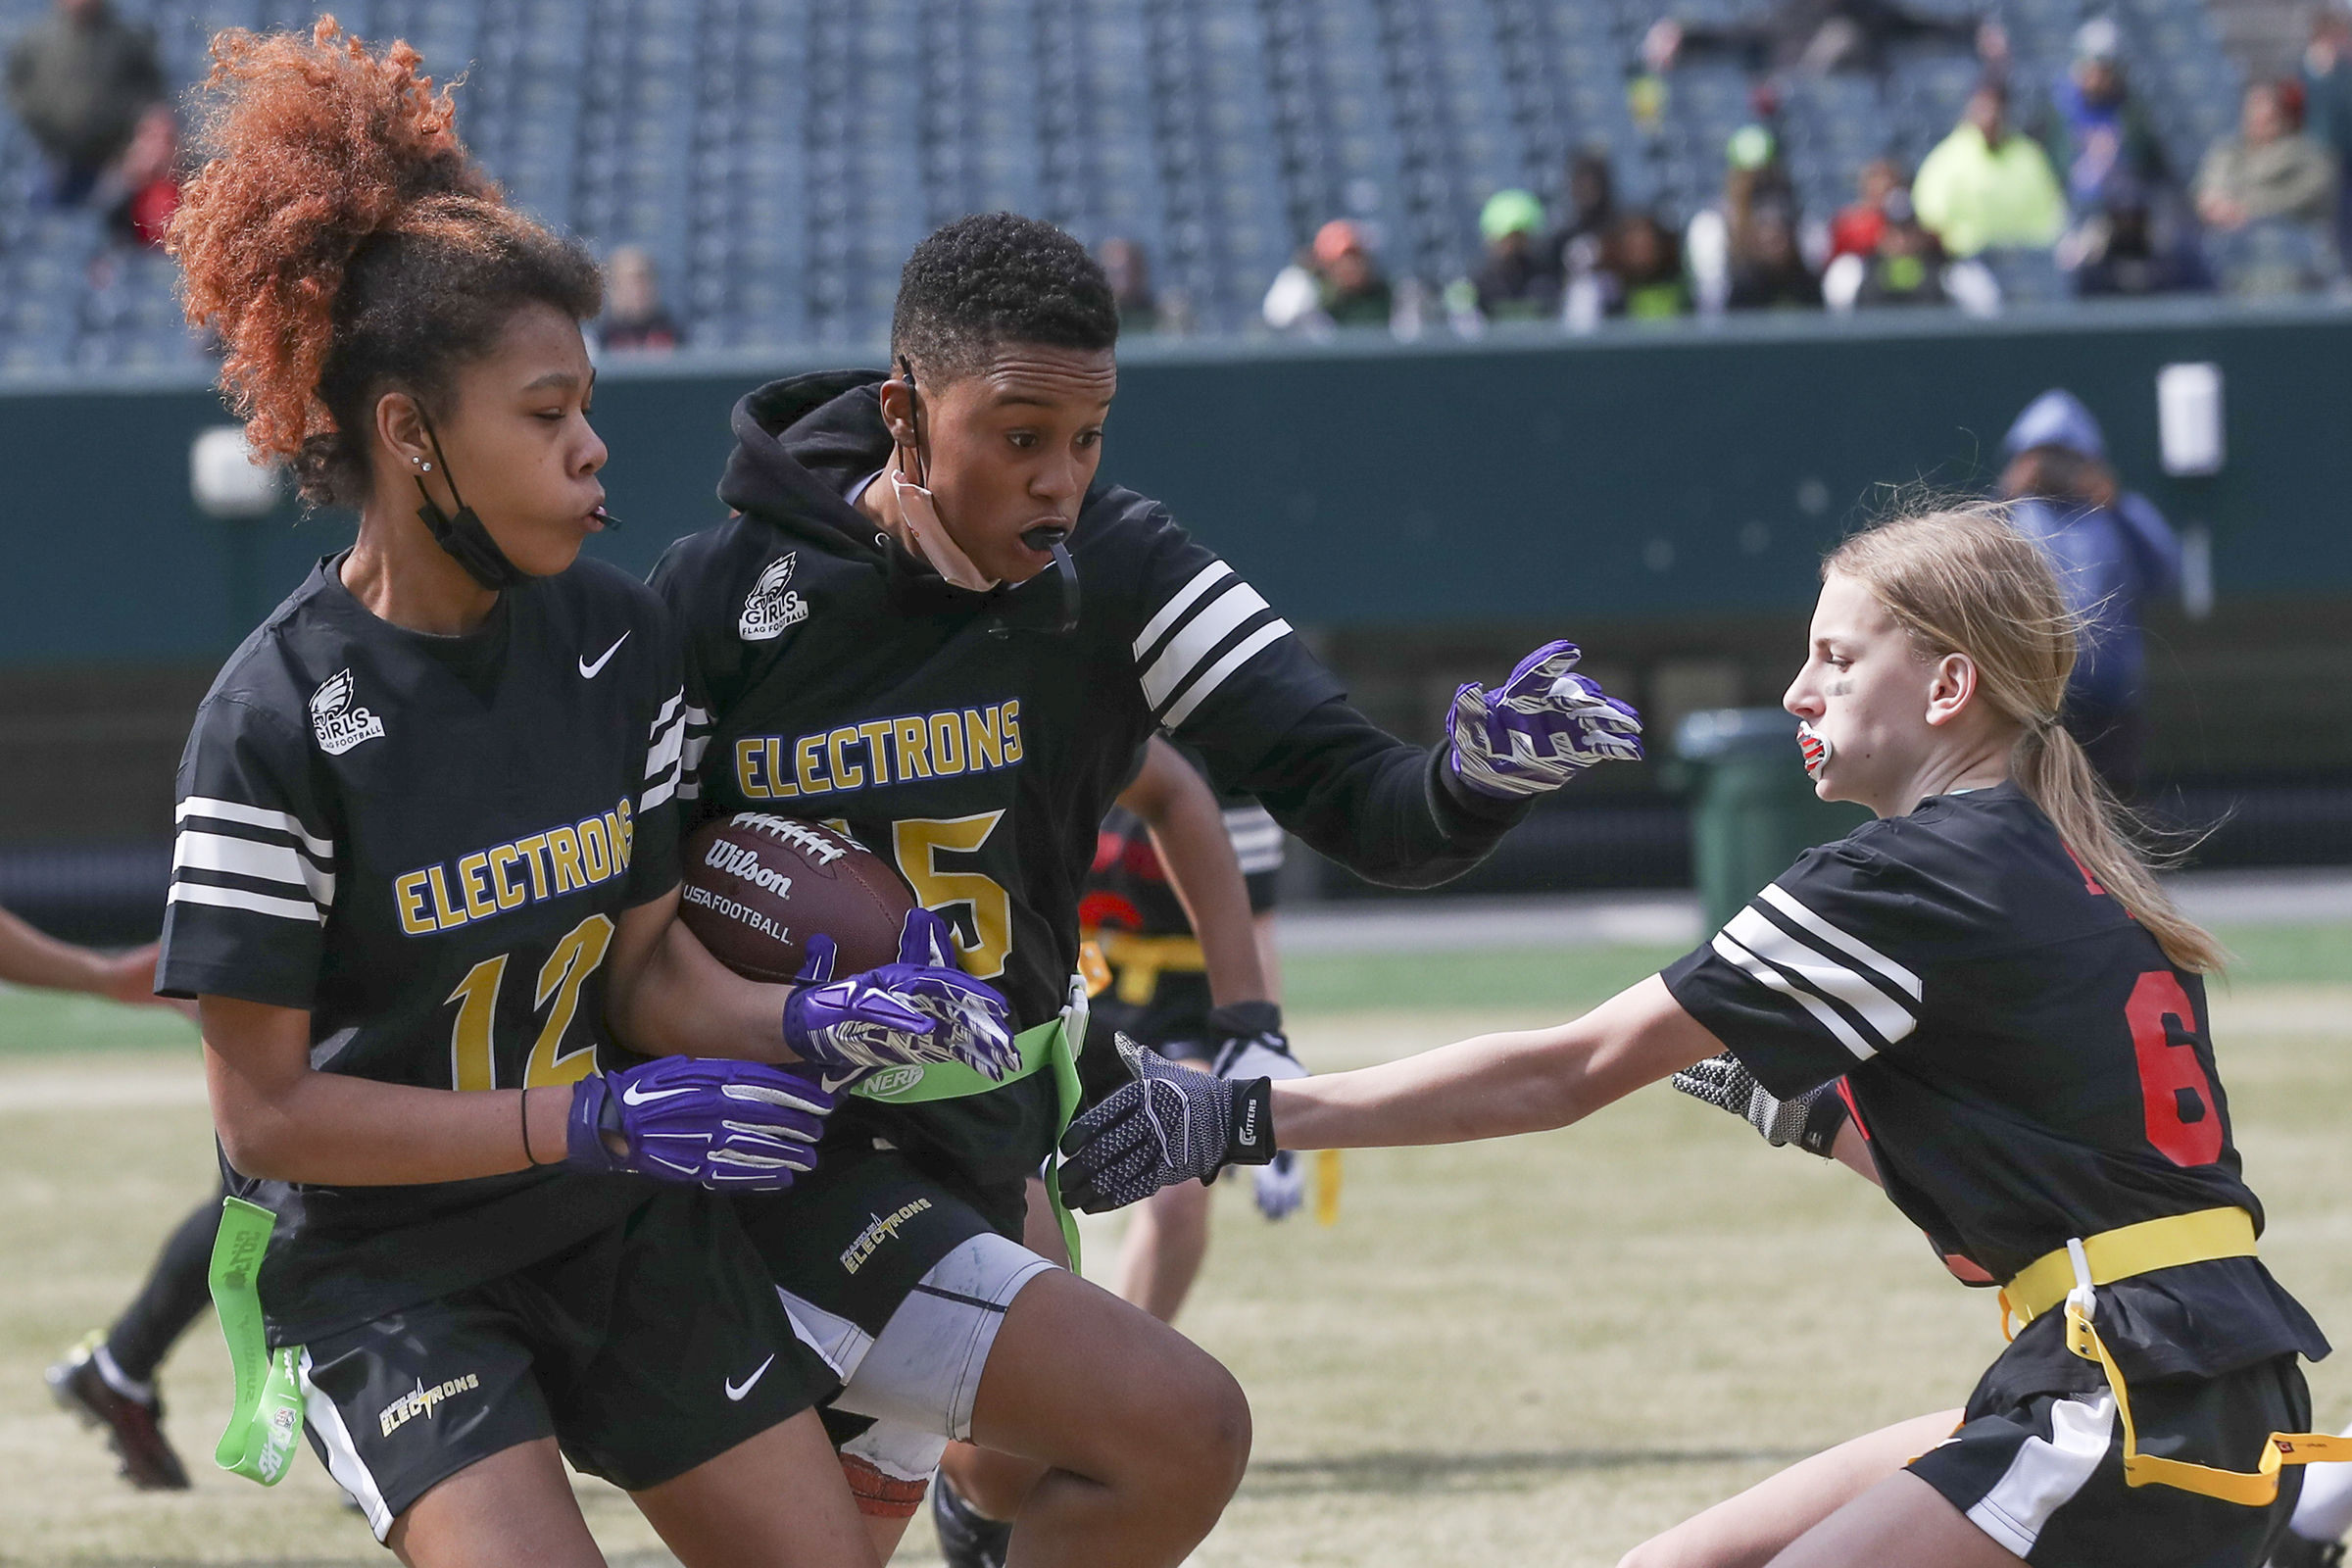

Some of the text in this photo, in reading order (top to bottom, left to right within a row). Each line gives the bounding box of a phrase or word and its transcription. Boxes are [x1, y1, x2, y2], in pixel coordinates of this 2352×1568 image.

[742, 610, 808, 635] FLAG FOOTBALL
[746, 593, 796, 624] GIRLS
[315, 710, 368, 740] GIRLS
[335, 726, 381, 748] FOOTBALL
[735, 698, 1024, 799] ELECTRONS
[394, 796, 634, 937] ELECTRONS
[705, 838, 793, 900] Wilson
[819, 808, 1012, 980] 5
[443, 913, 615, 1092] 12
[863, 1065, 922, 1095] NERF
[2125, 970, 2224, 1168] 6
[1239, 1099, 1257, 1147] CUTTERS
[844, 1198, 933, 1274] ELECTRONS
[380, 1373, 479, 1438] ELECTRONS
